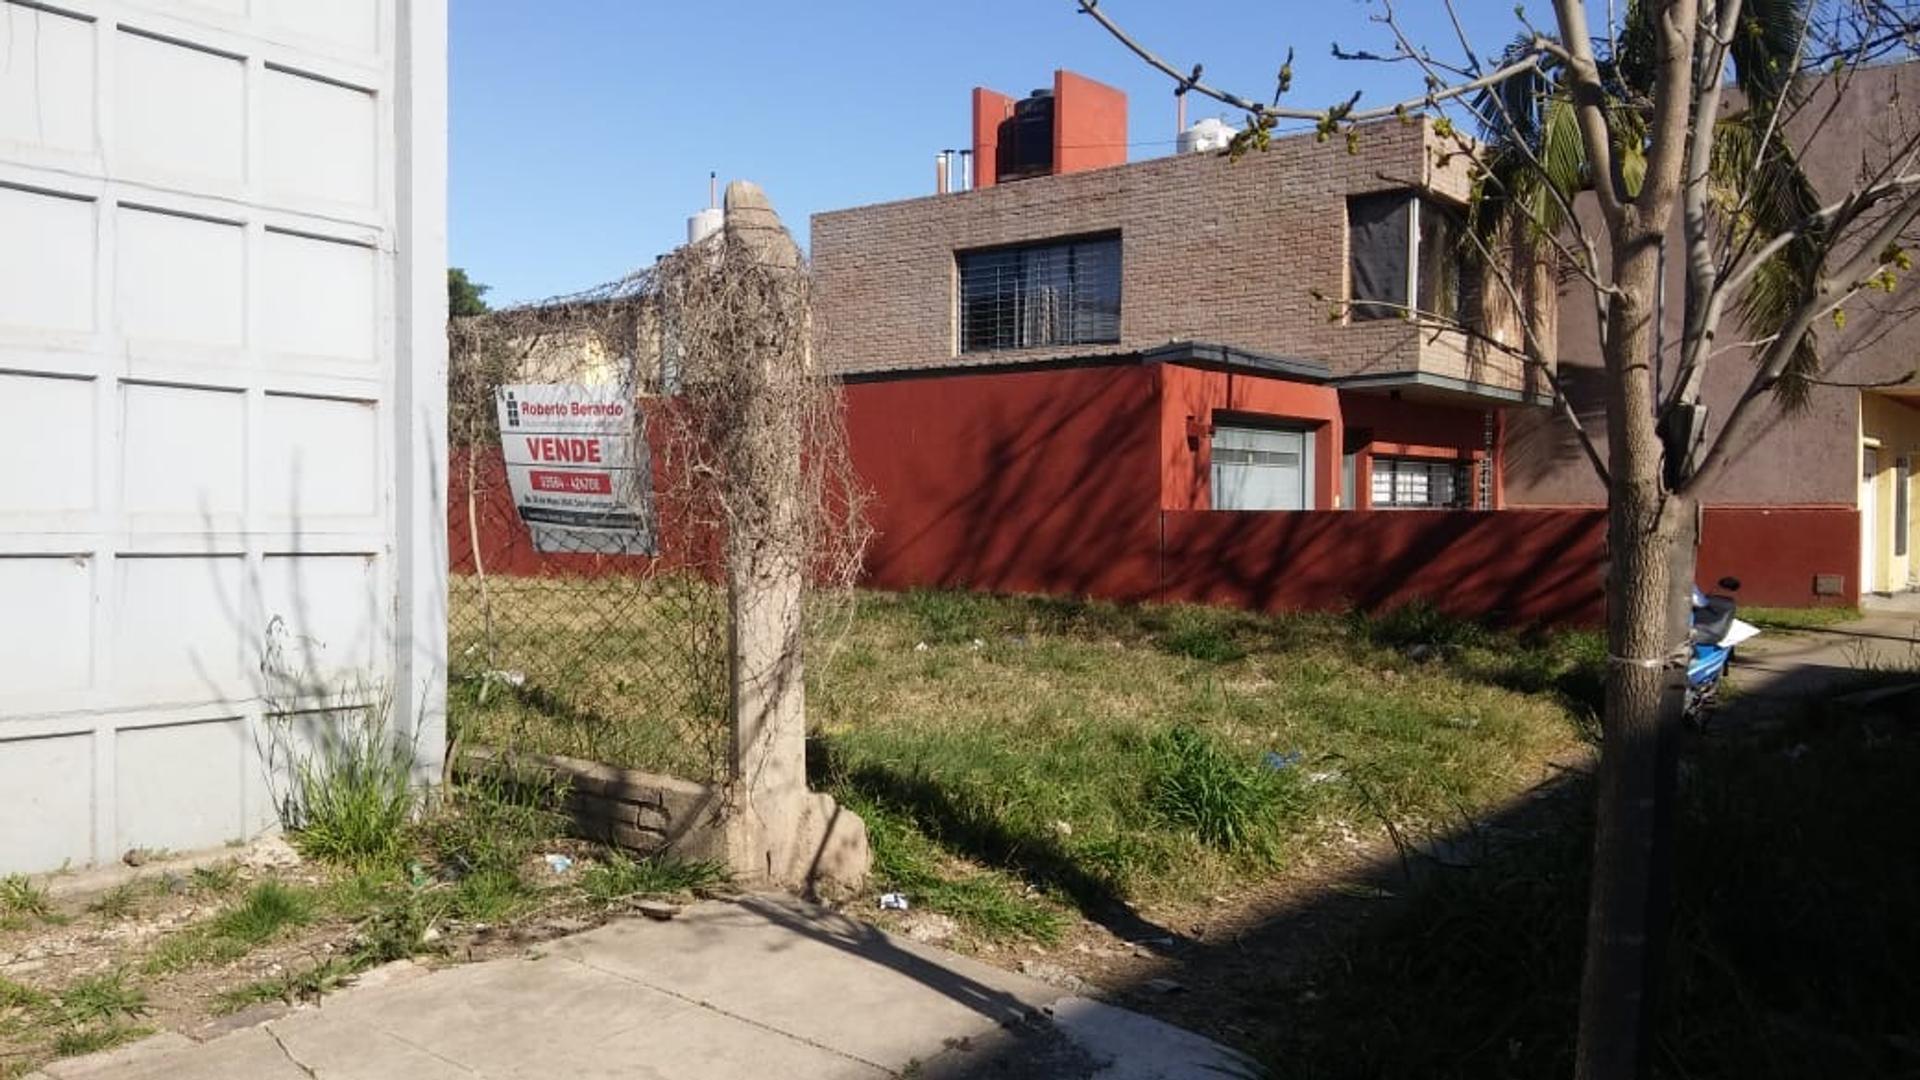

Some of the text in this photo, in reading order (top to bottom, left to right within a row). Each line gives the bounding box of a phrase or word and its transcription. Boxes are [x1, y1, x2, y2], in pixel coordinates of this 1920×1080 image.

[521, 401, 624, 417] Roberto Berardo
[526, 437, 602, 463] VENDE
